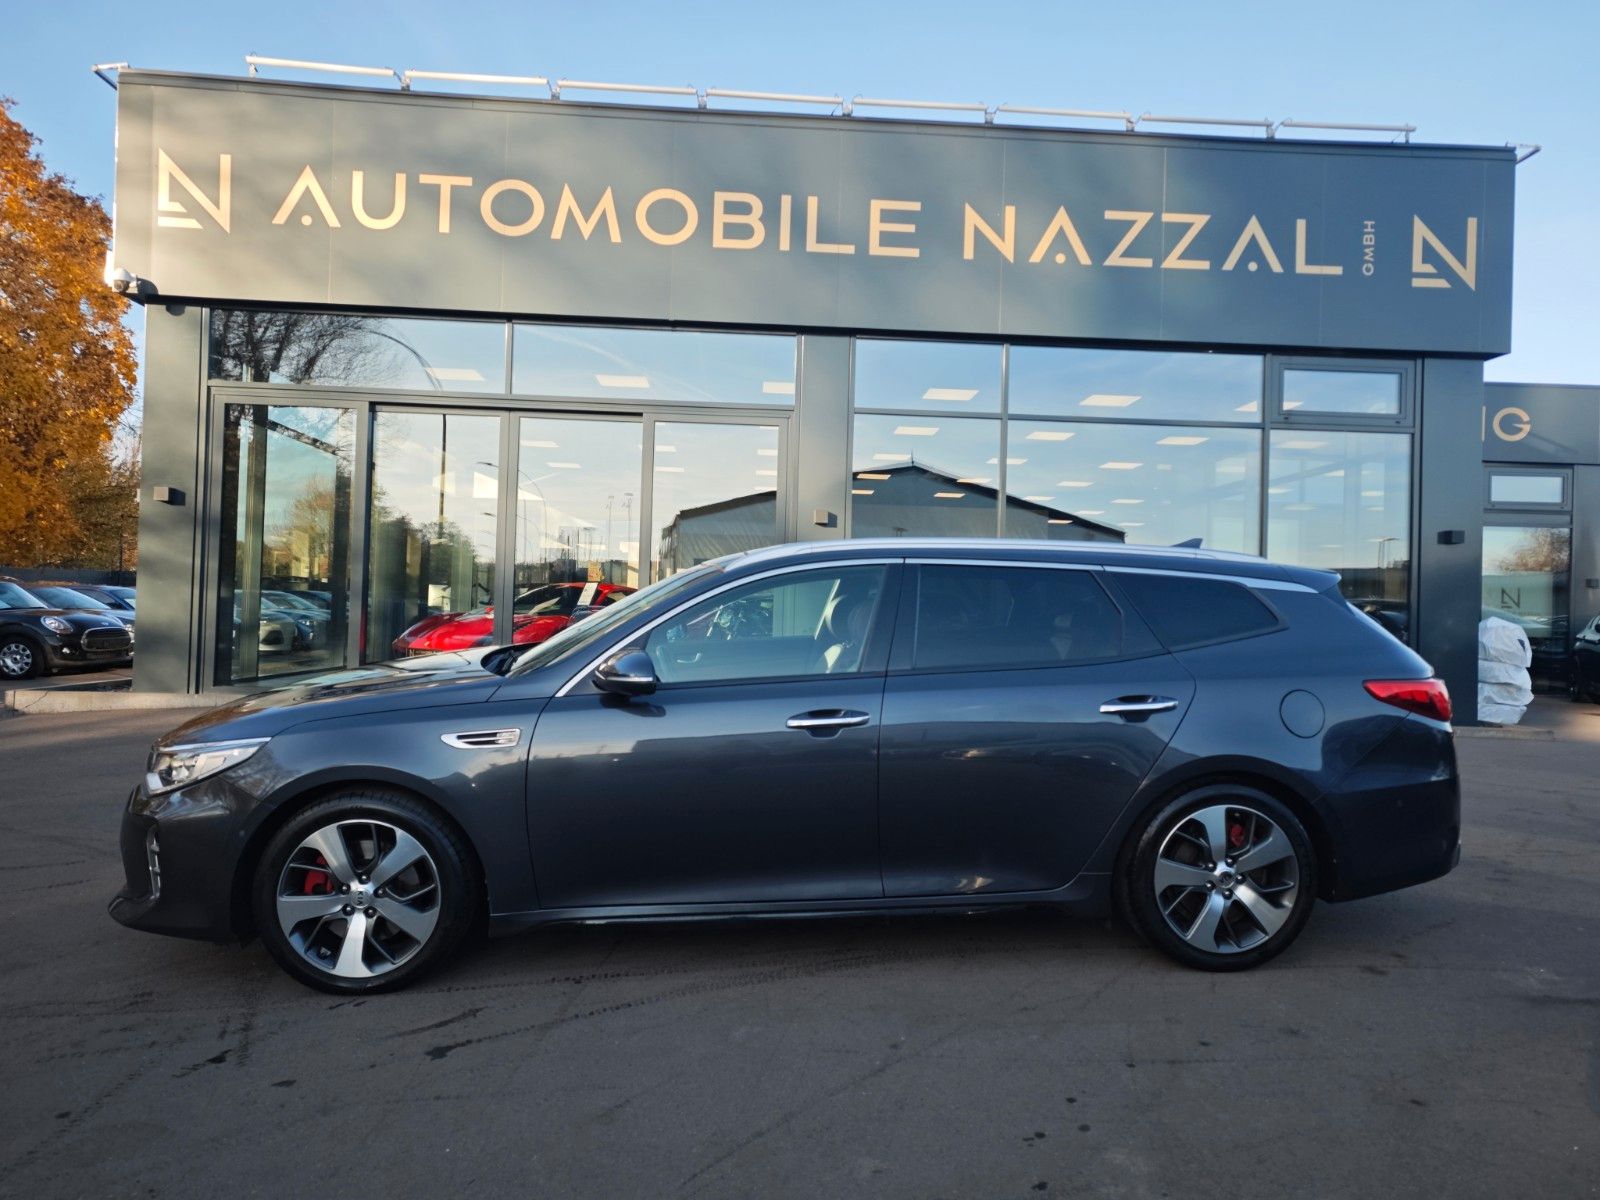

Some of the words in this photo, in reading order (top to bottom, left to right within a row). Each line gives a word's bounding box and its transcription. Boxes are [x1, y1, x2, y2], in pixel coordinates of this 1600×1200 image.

[271, 164, 922, 257] AUTOMOBILE
[963, 202, 1343, 276] NAZZAL
[1362, 220, 1375, 276] GMBH
